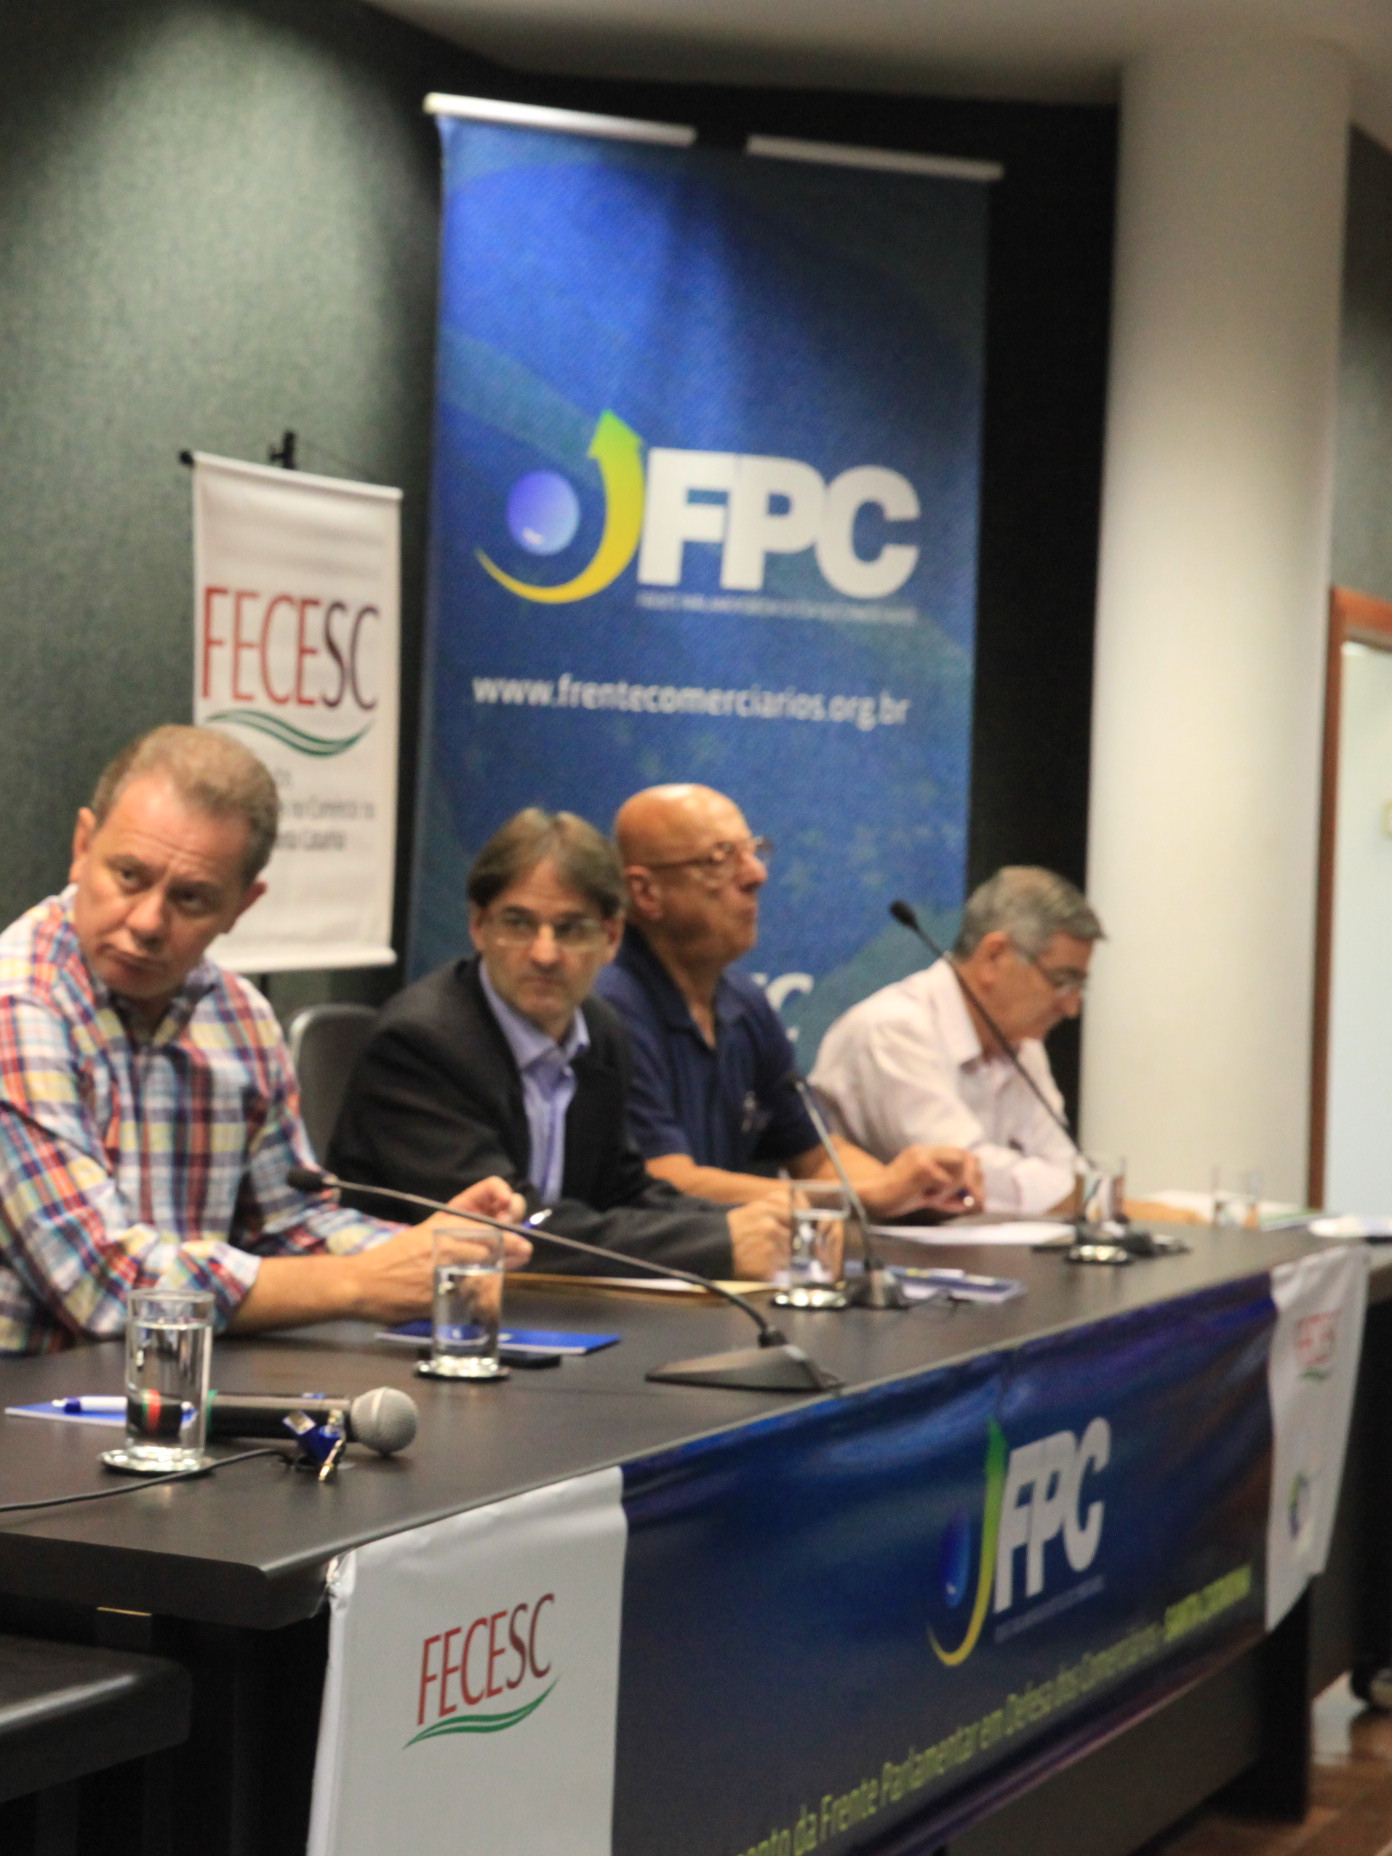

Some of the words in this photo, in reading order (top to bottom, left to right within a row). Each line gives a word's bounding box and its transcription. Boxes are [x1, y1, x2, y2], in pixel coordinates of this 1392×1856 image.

[637, 447, 920, 600] FPC
[202, 586, 380, 711] FECESC
[472, 673, 908, 732] www.frentecomerciarios.org.br
[994, 1416, 1111, 1614] FPC
[417, 1592, 555, 1726] FECESC
[820, 1779, 878, 1842] Frente
